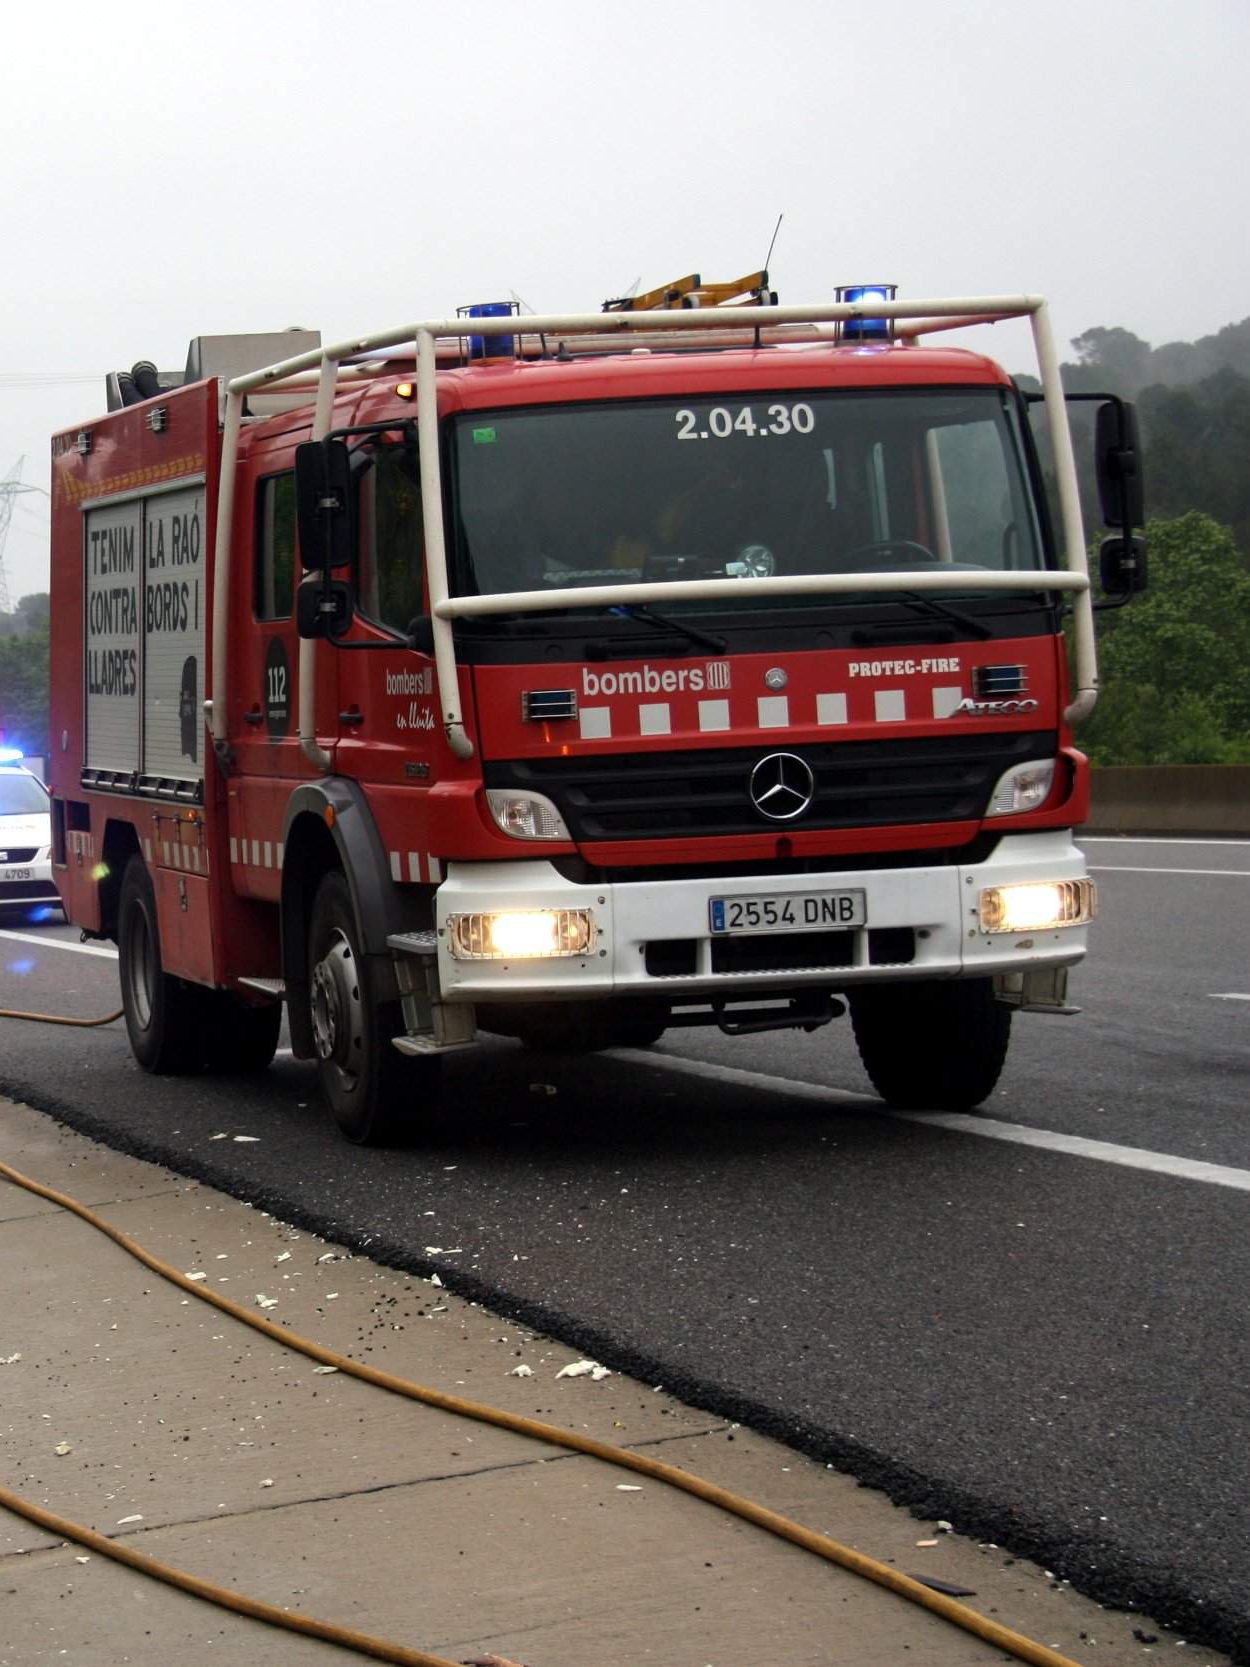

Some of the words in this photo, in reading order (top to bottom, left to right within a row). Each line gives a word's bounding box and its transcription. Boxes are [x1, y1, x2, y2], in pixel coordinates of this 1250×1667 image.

[675, 403, 815, 440] 2.04.30
[91, 526, 134, 575] TENIM
[149, 519, 165, 569] LA
[172, 499, 200, 566] RAÓ
[90, 586, 138, 635] CONTRA
[147, 581, 189, 633] BORDS
[89, 649, 137, 696] LLADRES
[268, 666, 287, 703] 112
[386, 668, 424, 695] bombers
[582, 665, 705, 696] bombers
[848, 658, 961, 678] PROTEC-FIRE
[4, 869, 31, 879] 4709
[729, 900, 796, 927] 2554
[804, 897, 854, 923] DNB
